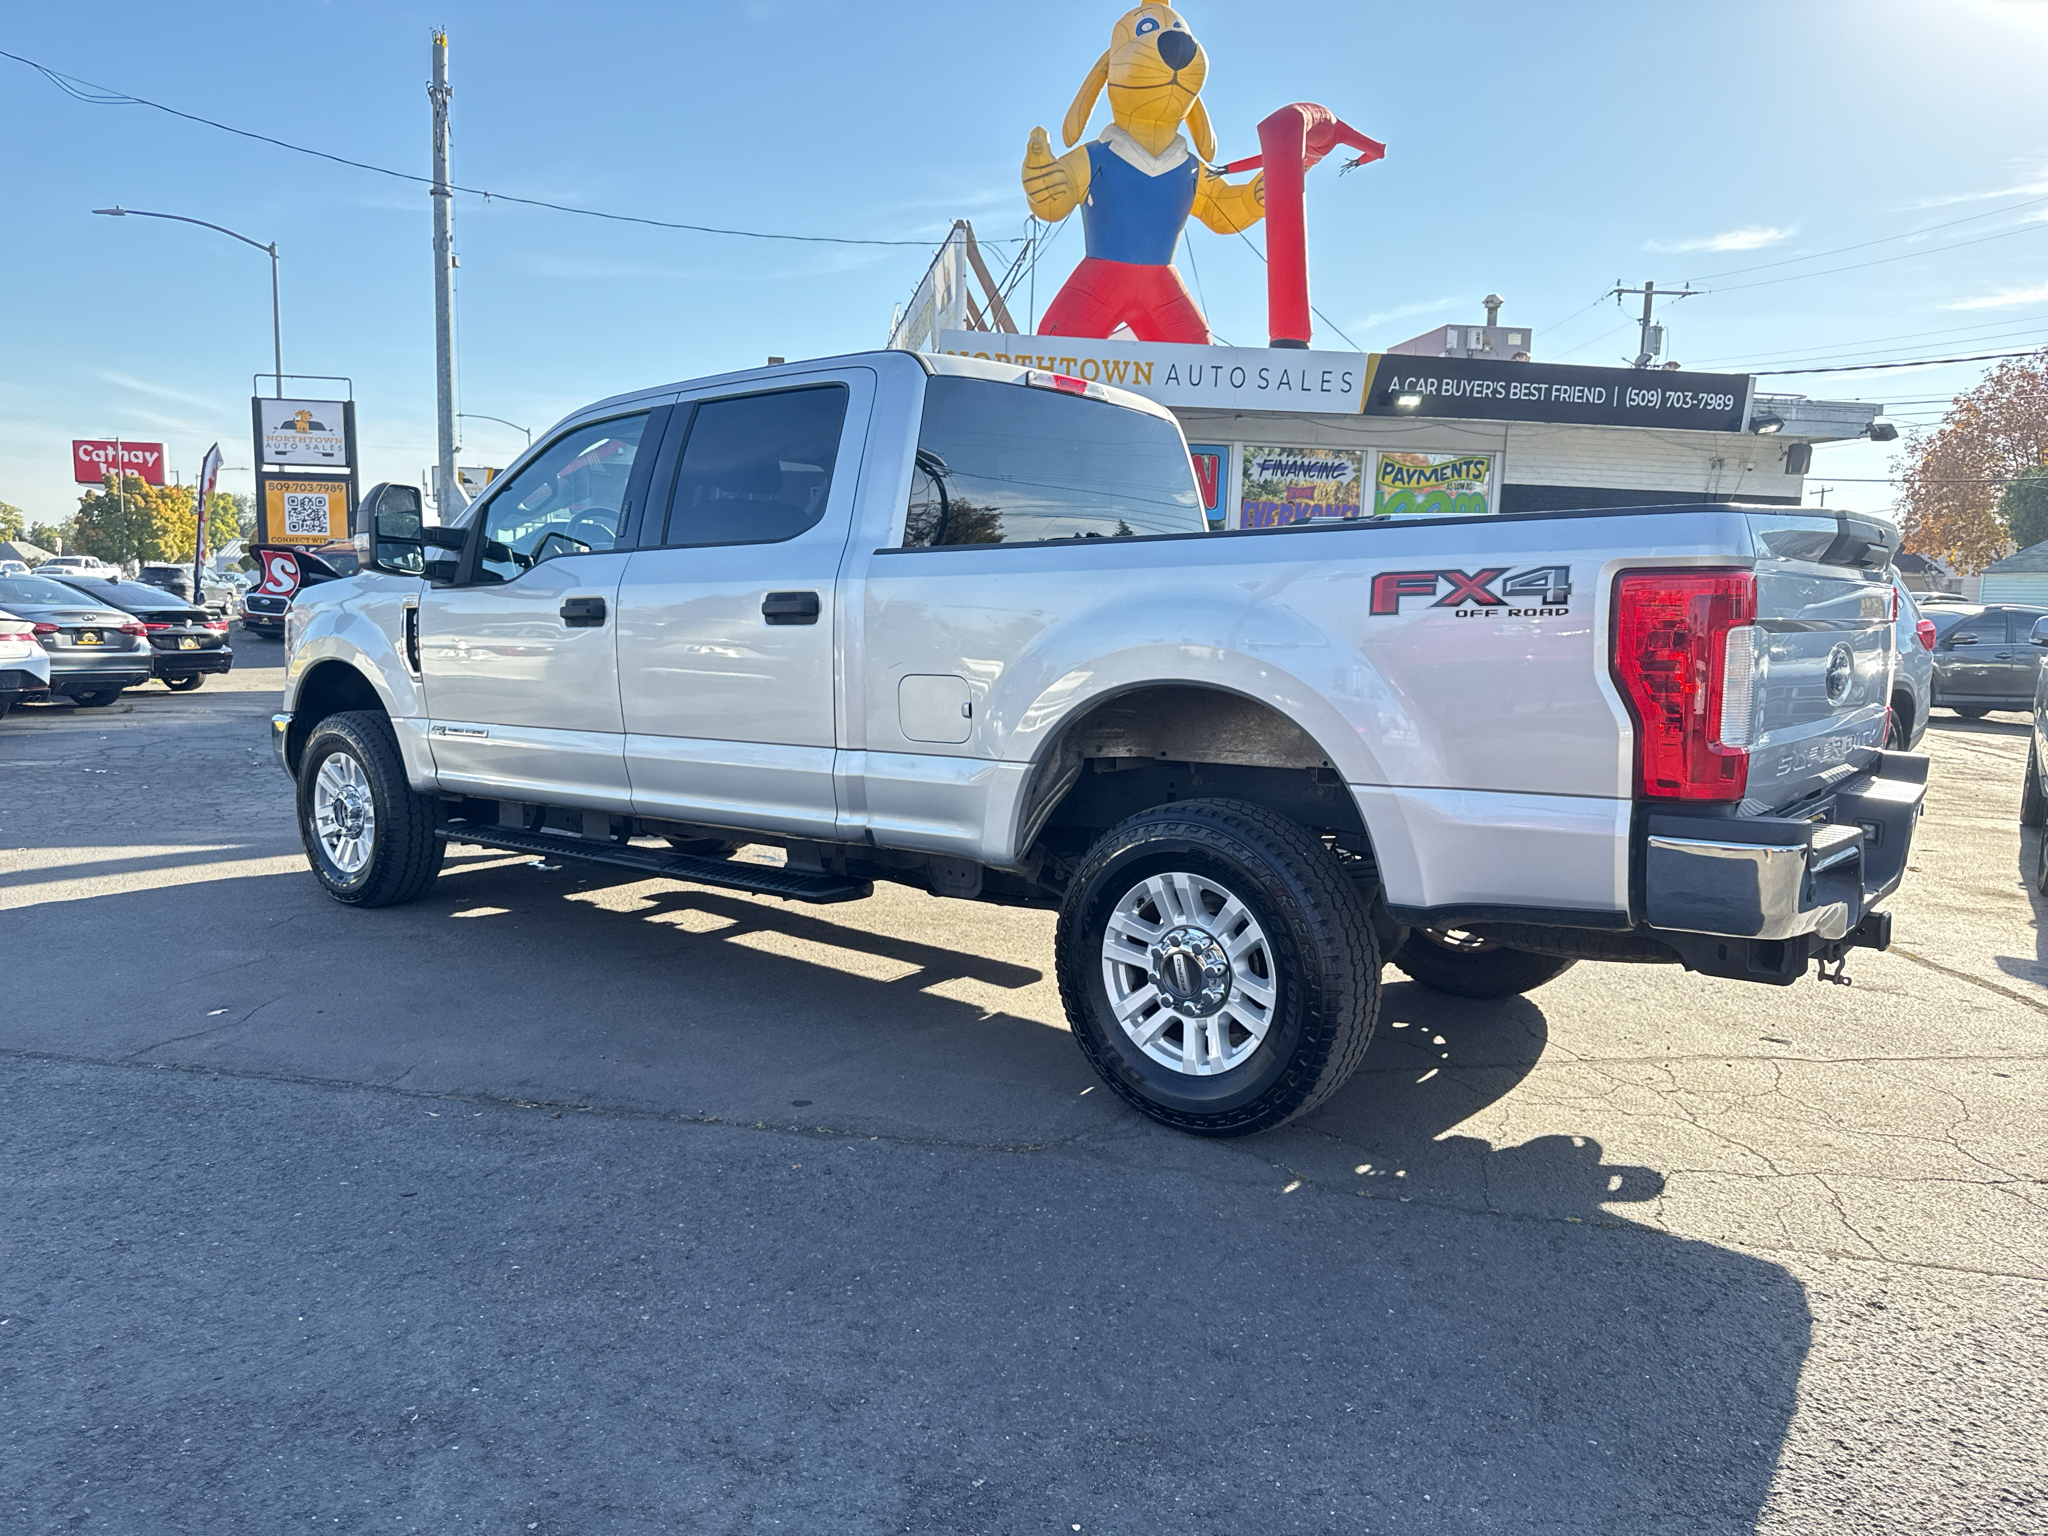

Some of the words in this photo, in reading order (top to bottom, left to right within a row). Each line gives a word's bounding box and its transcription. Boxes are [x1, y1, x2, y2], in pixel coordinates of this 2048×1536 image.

[1165, 363, 1246, 389] AUTO
[1257, 367, 1354, 394] SALES
[1404, 377, 1438, 396] CAR
[1441, 378, 1506, 399] BUYER'S
[1509, 382, 1548, 401] BEST
[1551, 385, 1607, 405] FRIEND
[1626, 386, 1662, 410] (509)
[1665, 391, 1734, 411] 703-7989
[265, 434, 343, 444] NORTHTOWN
[265, 442, 298, 450] AUTO
[305, 444, 344, 452] SALES
[78, 444, 159, 467] Cathay
[1259, 458, 1347, 480] FINANCING
[1381, 459, 1485, 486] PAYMENTS
[268, 482, 344, 493] 509-703-7989
[1287, 486, 1313, 501] FOR
[270, 536, 310, 544] CONNECT
[1368, 564, 1573, 617] FX4
[1455, 608, 1499, 618] OFF
[1507, 608, 1570, 617] ROAD
